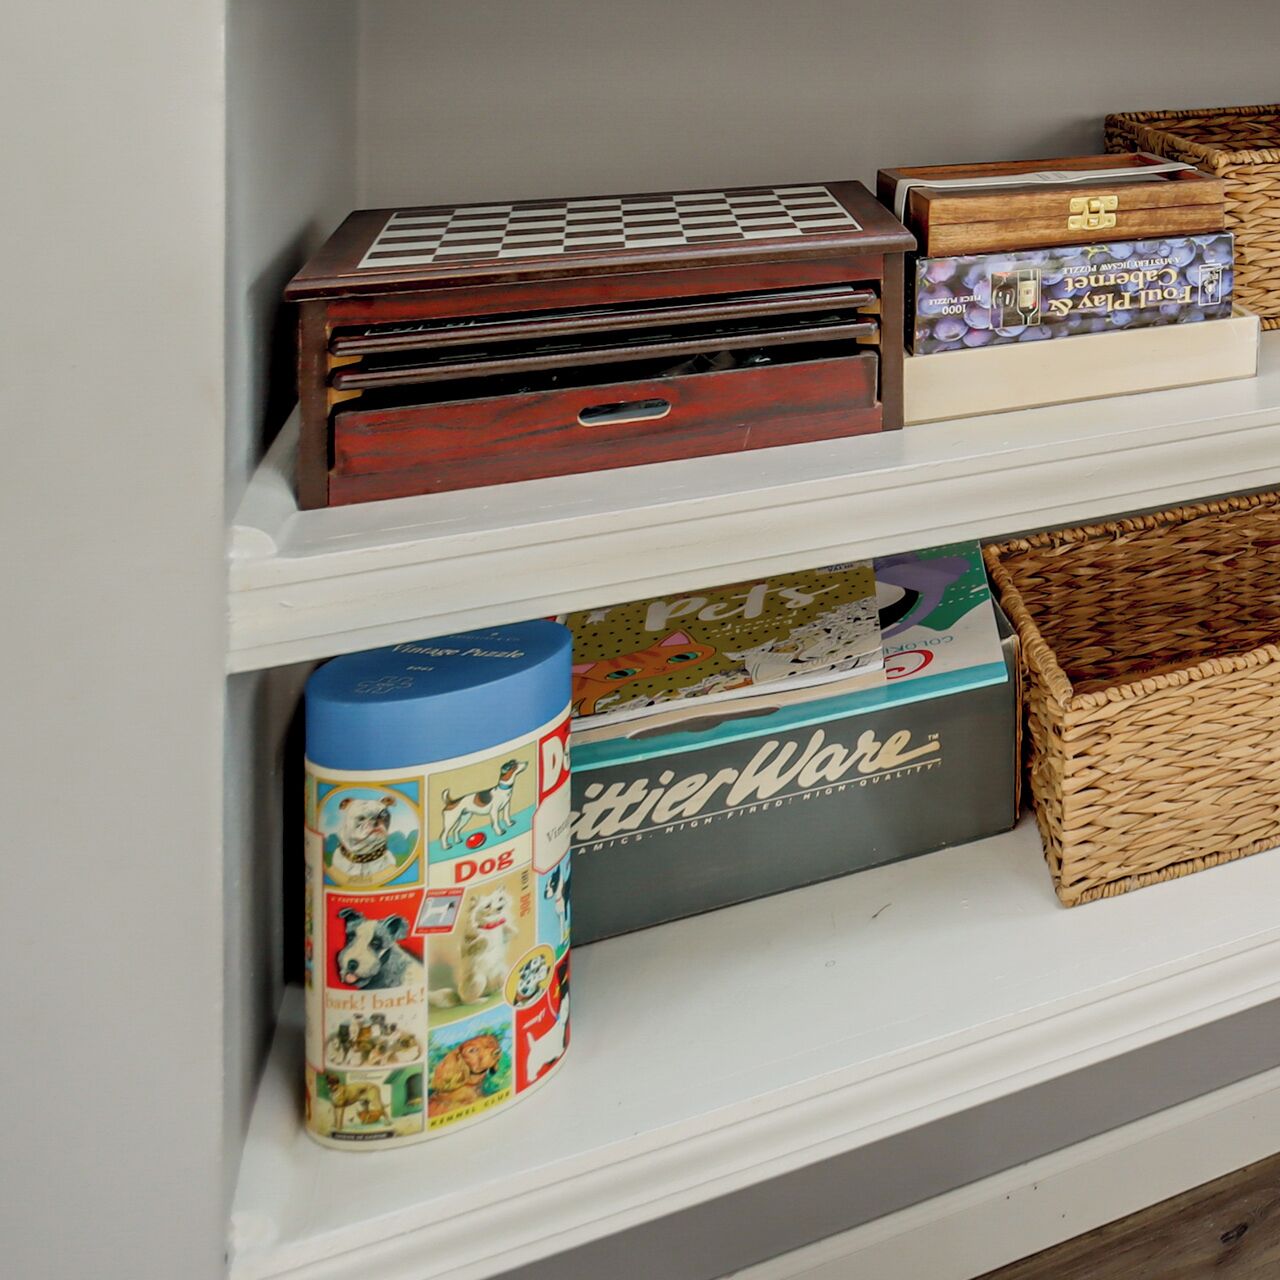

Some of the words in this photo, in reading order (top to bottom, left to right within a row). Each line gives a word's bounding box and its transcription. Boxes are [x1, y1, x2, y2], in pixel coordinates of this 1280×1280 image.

[1062, 264, 1097, 274] PUZZLE
[1098, 260, 1132, 270] JIGSAW
[1133, 258, 1173, 267] MYSTERY
[1064, 267, 1177, 294] Cabernet
[928, 297, 956, 307] PUZZLE
[958, 295, 982, 304] PIECE
[1078, 290, 1132, 312] Play
[1139, 285, 1193, 308] Foul
[941, 304, 968, 315] 1000
[1047, 298, 1073, 317] &
[392, 643, 460, 657] Vintage
[461, 648, 524, 658] Puzzle
[455, 848, 515, 884] Dog
[380, 892, 416, 902] FRIEND
[372, 987, 425, 1008] bark!
[430, 1107, 476, 1127] KENNEL
[484, 1090, 510, 1108] CLUB
